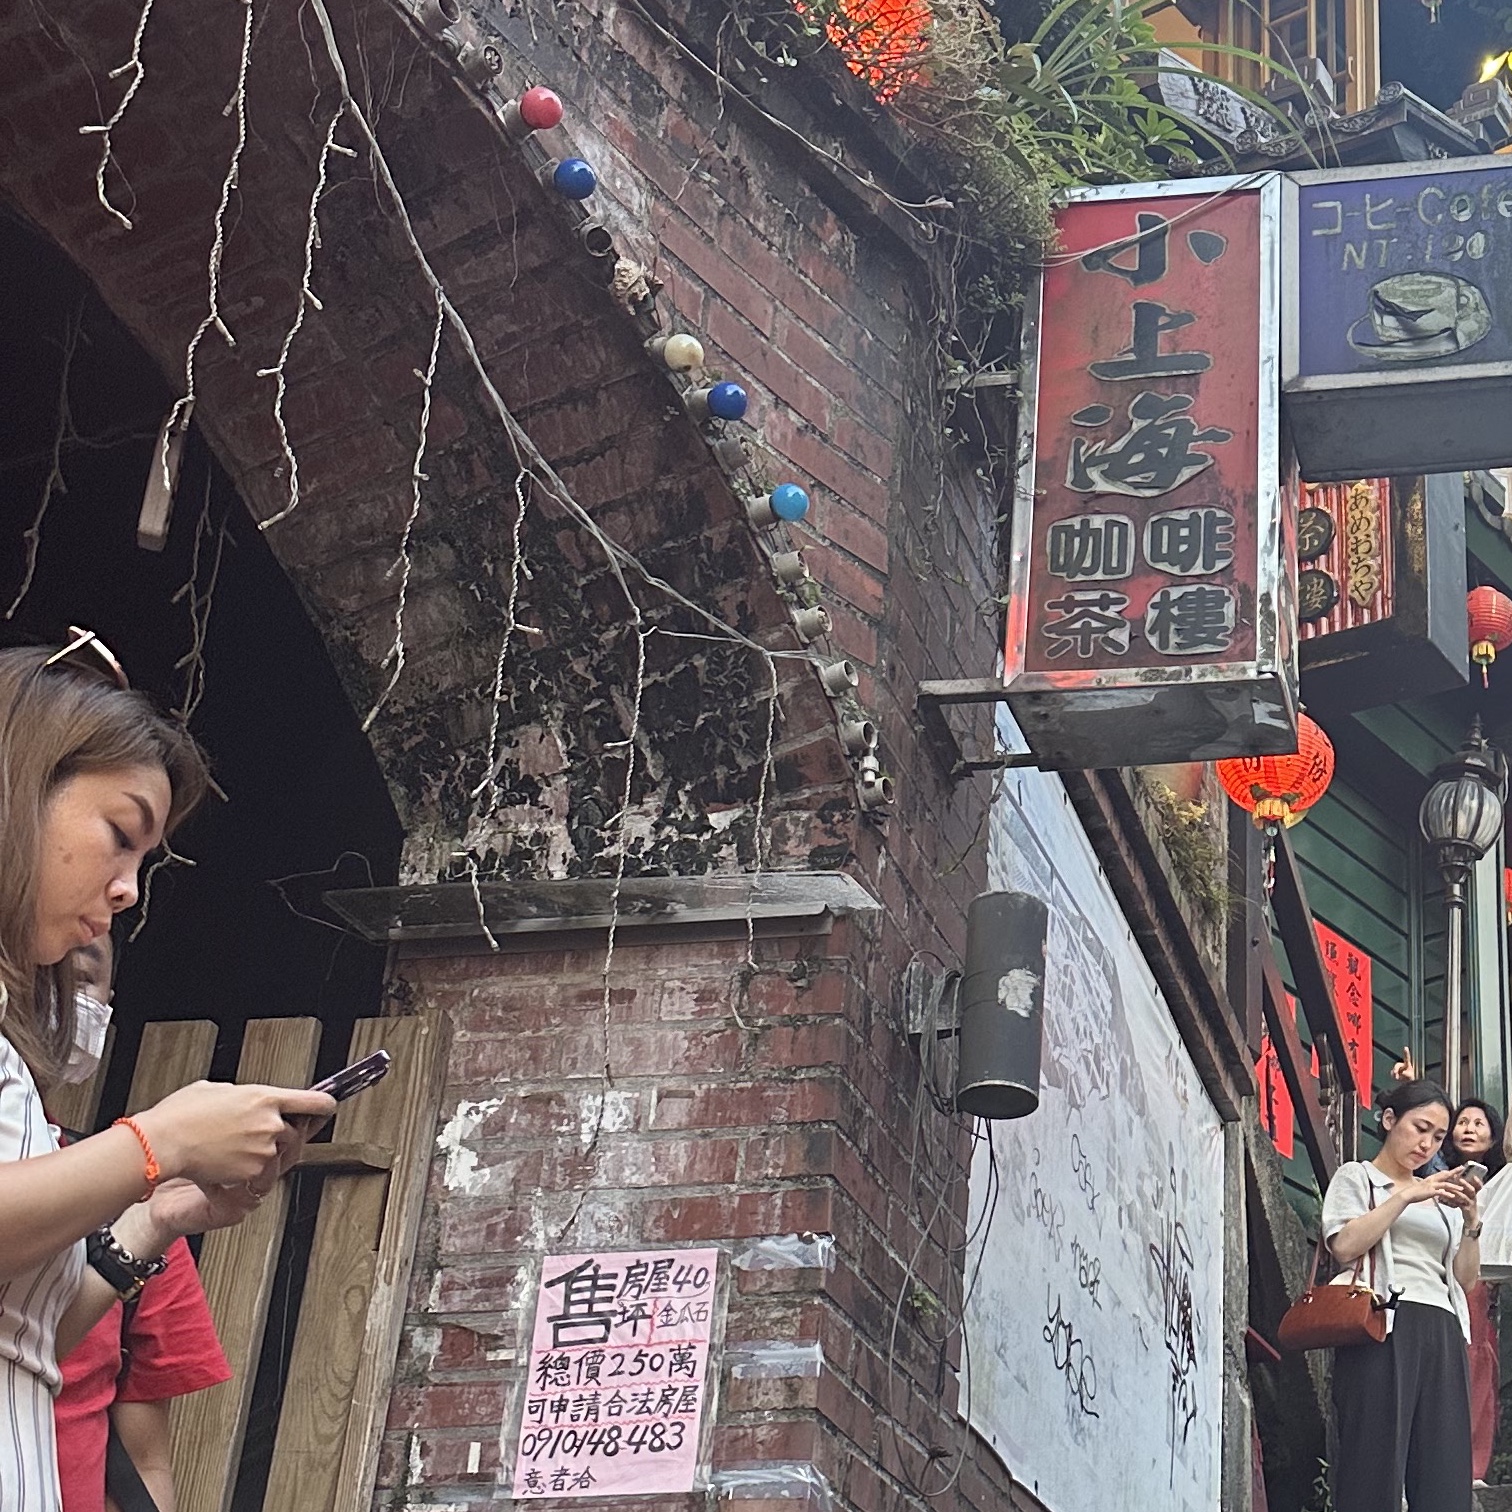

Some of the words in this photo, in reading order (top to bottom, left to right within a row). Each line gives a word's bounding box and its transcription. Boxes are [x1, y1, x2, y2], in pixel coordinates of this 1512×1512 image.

[1065, 211, 1233, 497] 小上海
[1047, 508, 1236, 581] 咖啡
[1043, 584, 1236, 660] 茶樓
[545, 1258, 618, 1349] 售
[614, 1302, 653, 1337] 坪
[656, 1301, 709, 1329] 金瓜石
[535, 1343, 698, 1392] 總價250萬
[527, 1384, 699, 1425] 可申請合法房屋
[522, 1465, 598, 1495] 意者洽
